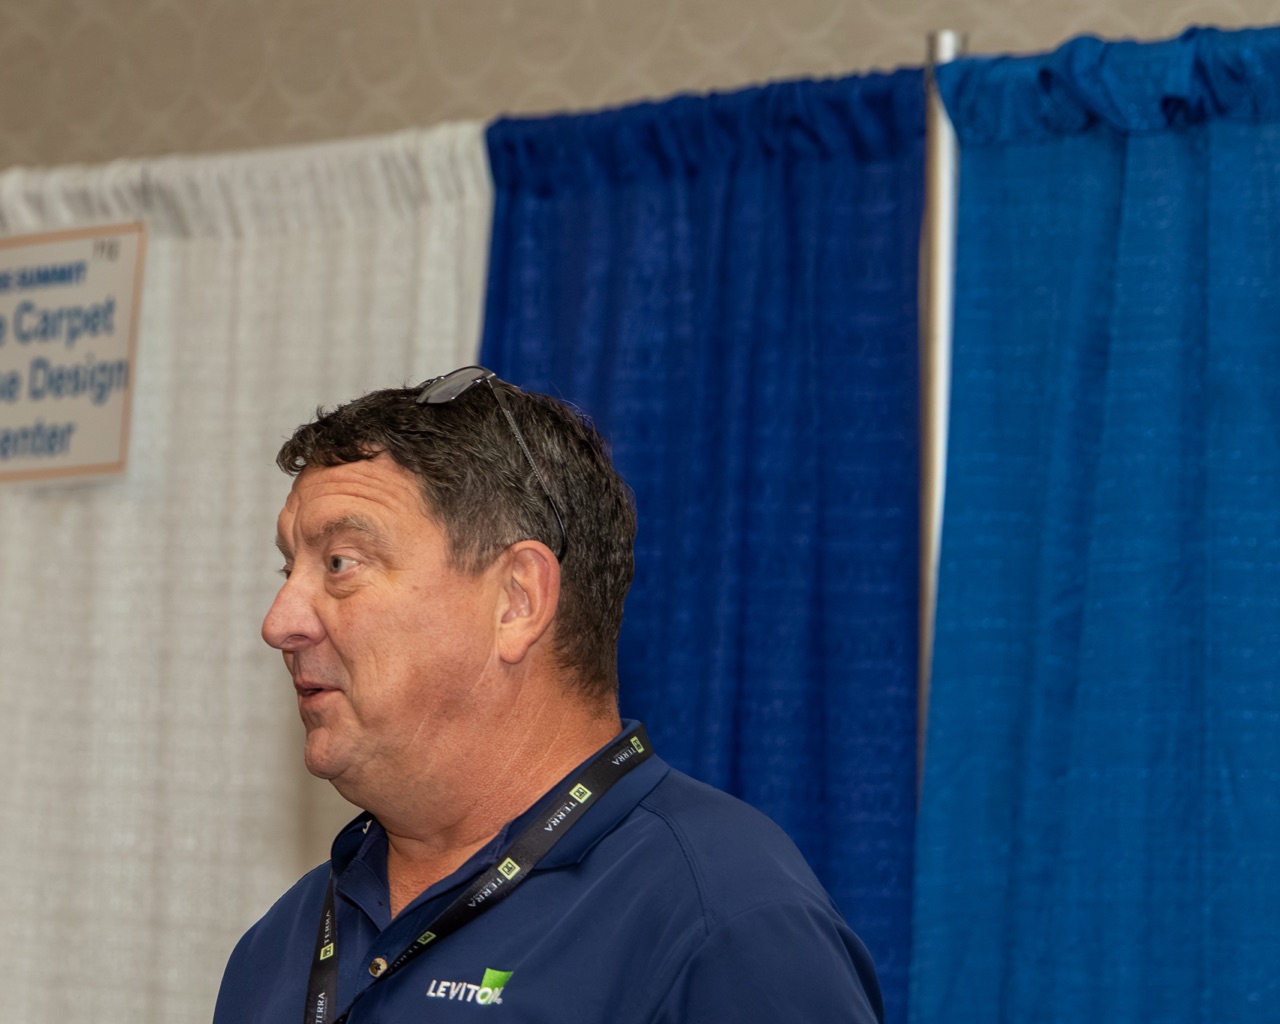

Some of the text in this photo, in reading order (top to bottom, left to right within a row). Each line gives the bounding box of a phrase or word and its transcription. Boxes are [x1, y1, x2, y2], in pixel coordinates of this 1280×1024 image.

[13, 296, 116, 349] Carpet
[28, 354, 130, 407] Design
[611, 746, 637, 766] TERRA
[544, 801, 578, 832] TERRA
[468, 877, 505, 908] TERRA
[316, 992, 326, 1024] TERRA
